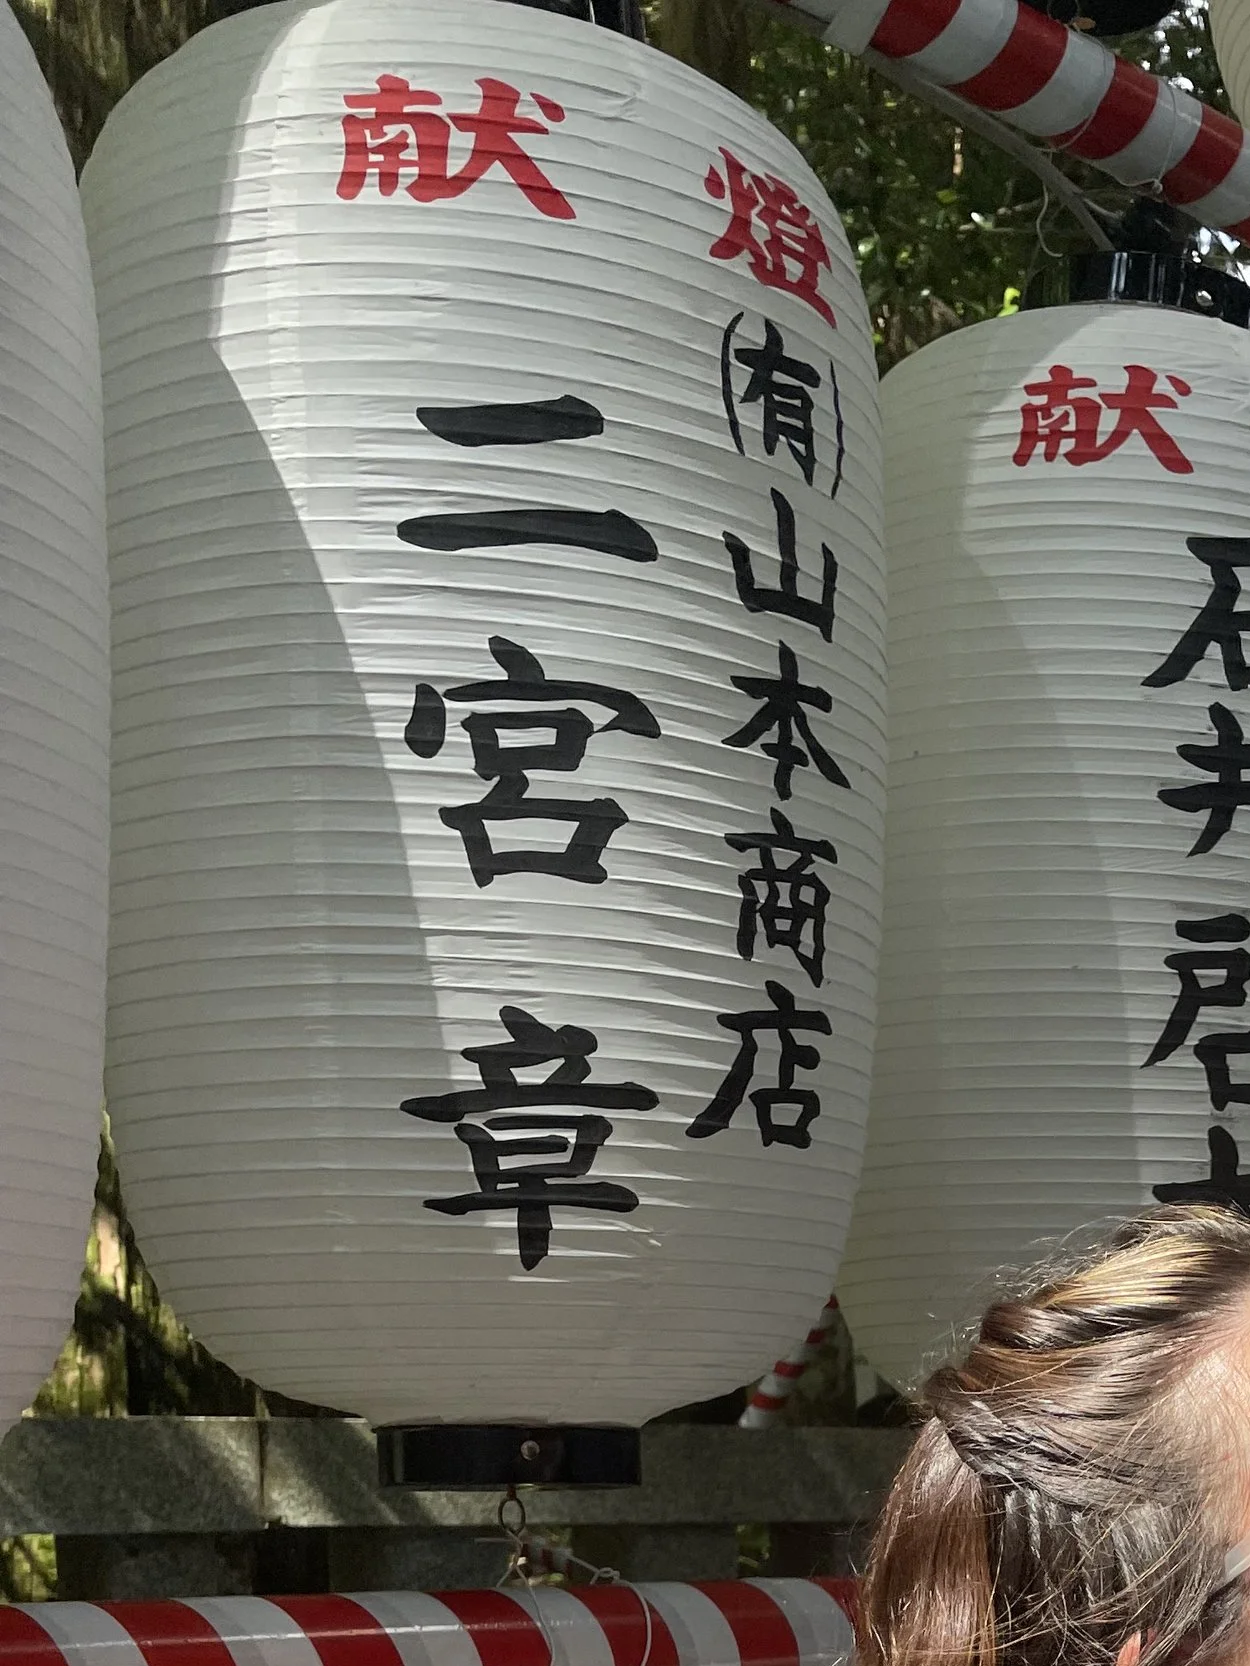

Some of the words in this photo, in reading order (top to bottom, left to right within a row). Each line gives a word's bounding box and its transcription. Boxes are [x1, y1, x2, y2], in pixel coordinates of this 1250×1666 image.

[336, 74, 576, 219] 献
[704, 146, 837, 329] 燈
[1012, 365, 1194, 474] 献
[397, 395, 662, 1270] 二宮章
[686, 312, 851, 1148] (有)山本商店
